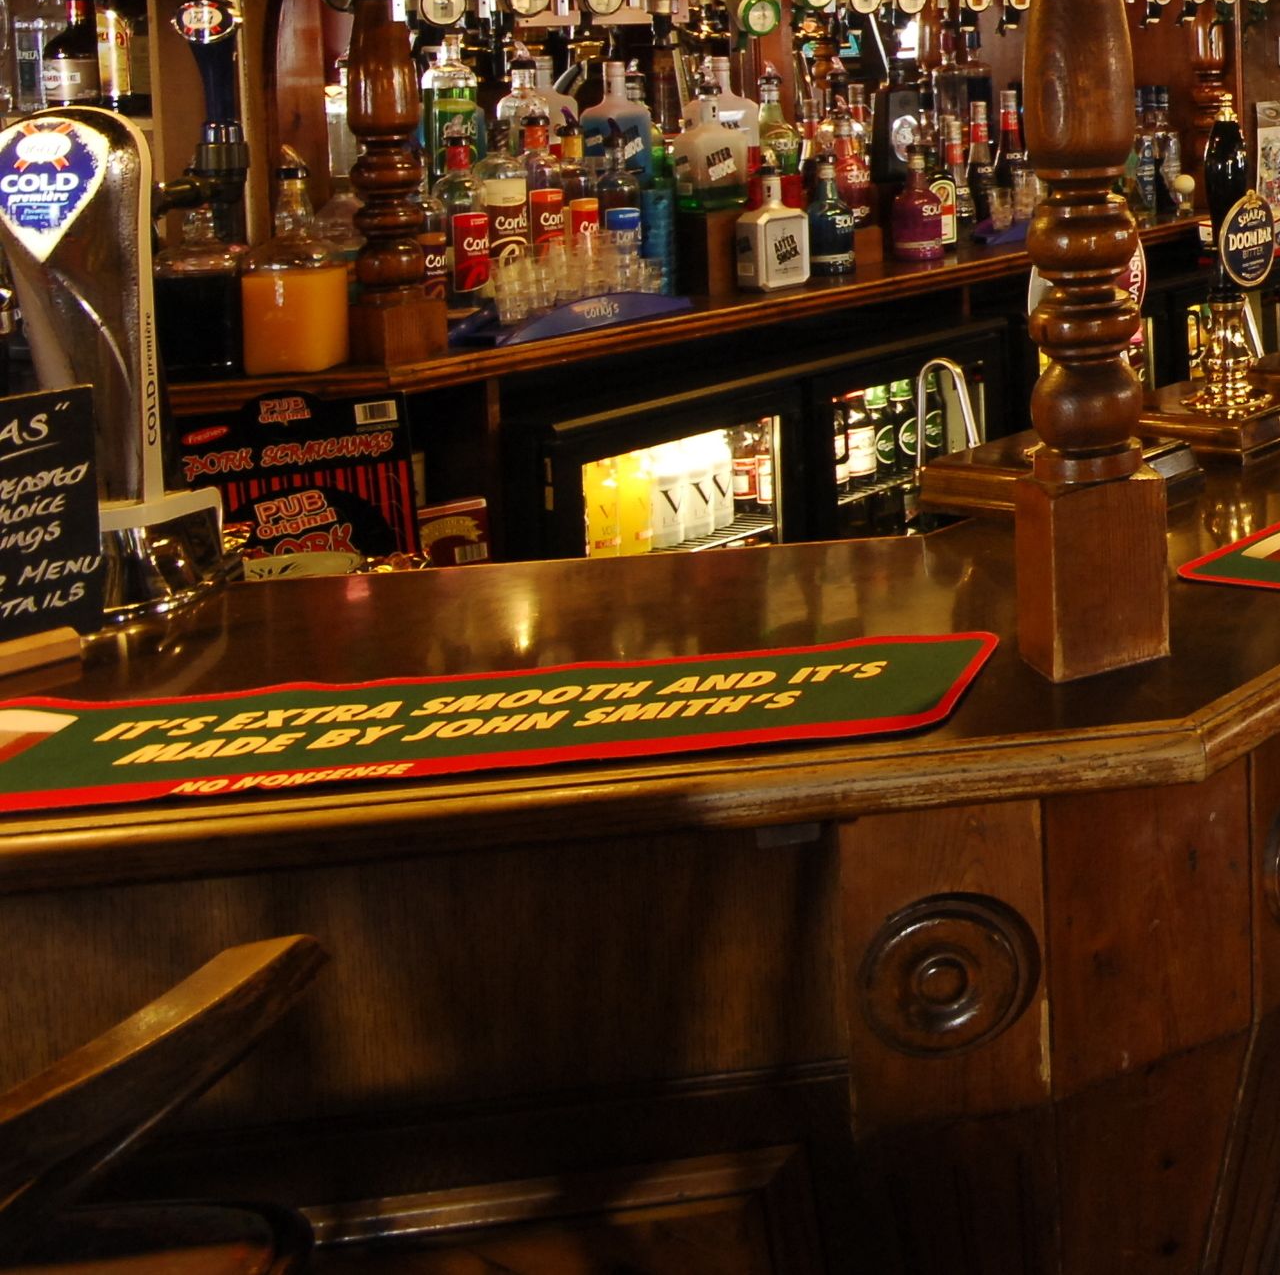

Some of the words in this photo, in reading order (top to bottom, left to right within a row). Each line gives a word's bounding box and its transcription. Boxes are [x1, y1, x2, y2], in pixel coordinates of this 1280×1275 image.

[0, 173, 79, 193] COLD
[147, 380, 158, 447] COLD
[258, 409, 311, 423] Original
[259, 397, 305, 413] PUB
[182, 448, 254, 482] PORK
[261, 431, 393, 467] SCRATCHINGS
[254, 490, 327, 525] PUB
[256, 510, 337, 540] Original
[18, 555, 101, 586] MENU
[94, 714, 217, 743] IT'S
[214, 700, 403, 733] EXTRA
[411, 680, 656, 717] SMOOTH
[664, 668, 784, 696] AND
[787, 660, 889, 686] IT'S
[112, 731, 306, 766] MADE
[306, 724, 404, 750] BY
[401, 709, 567, 742] JOHN
[573, 690, 802, 729] SMITH'S
[170, 778, 225, 795] NO
[230, 762, 414, 790] NONSENSE
